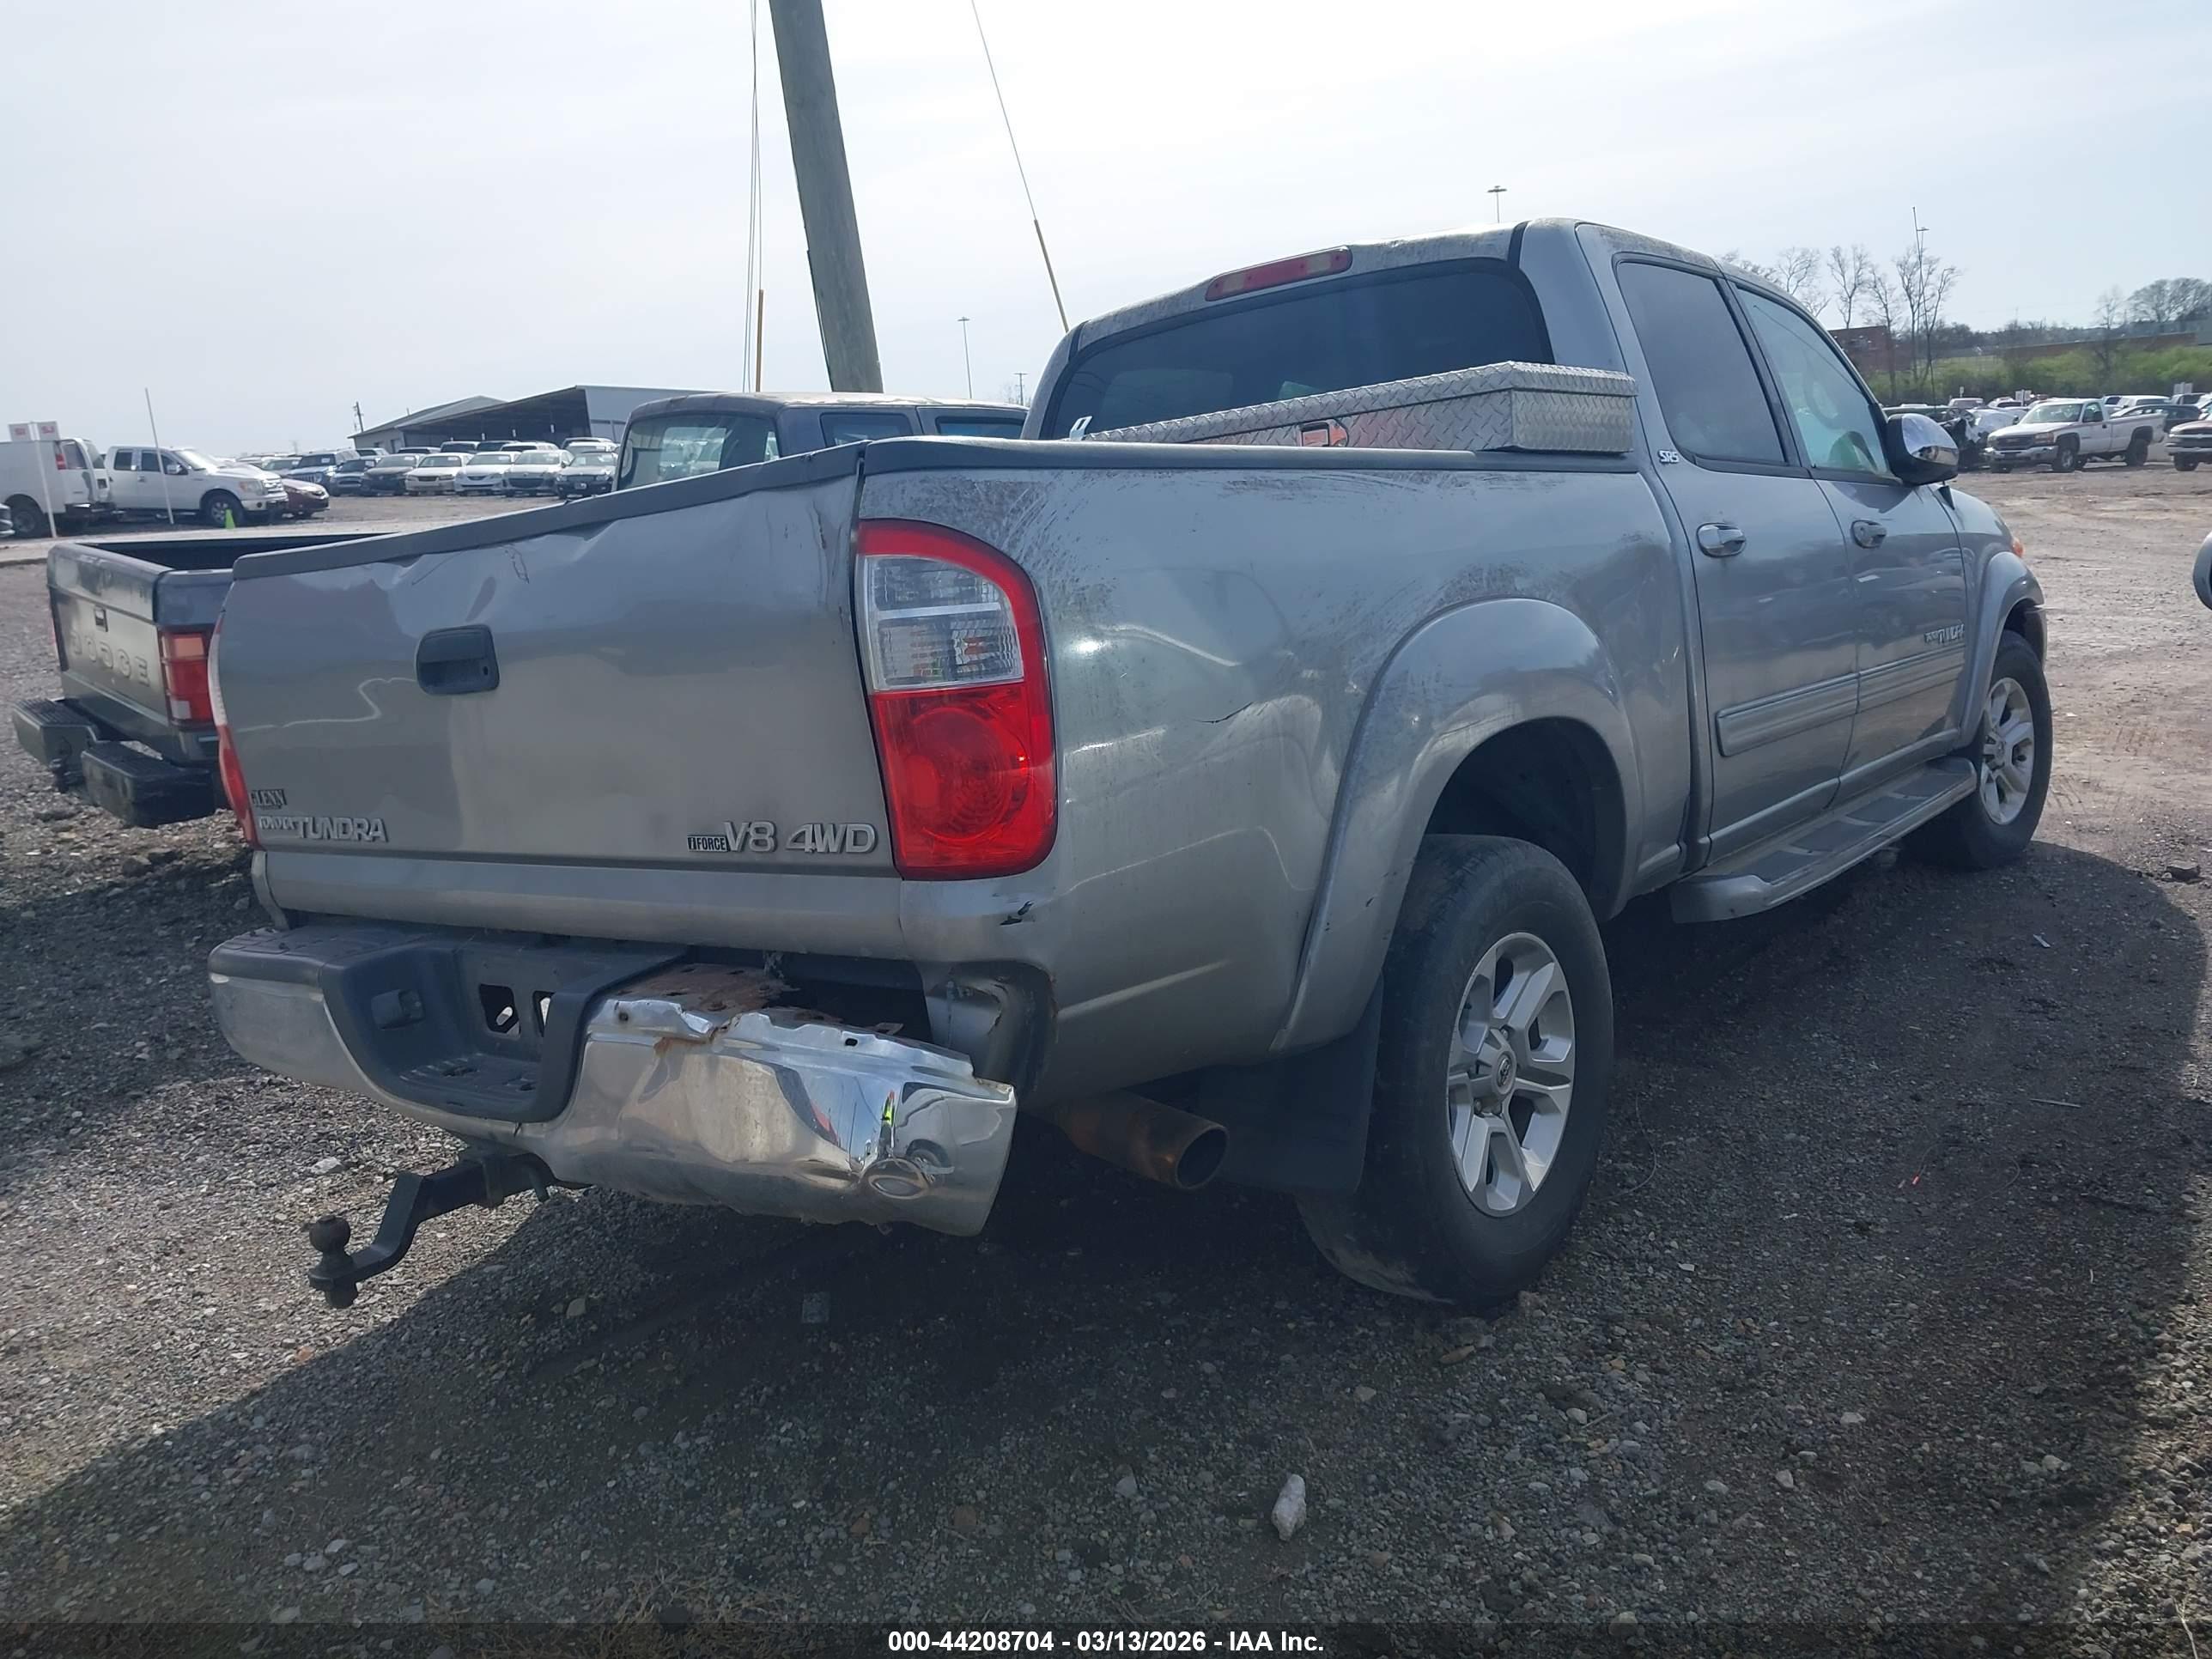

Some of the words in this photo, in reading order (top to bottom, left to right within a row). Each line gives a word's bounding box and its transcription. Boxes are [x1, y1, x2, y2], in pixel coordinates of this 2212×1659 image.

[1658, 450, 1680, 464] SR5
[70, 629, 150, 688] DODGE
[296, 817, 389, 842] TUNDRA
[724, 821, 776, 852] V8
[785, 823, 878, 854] 4WD
